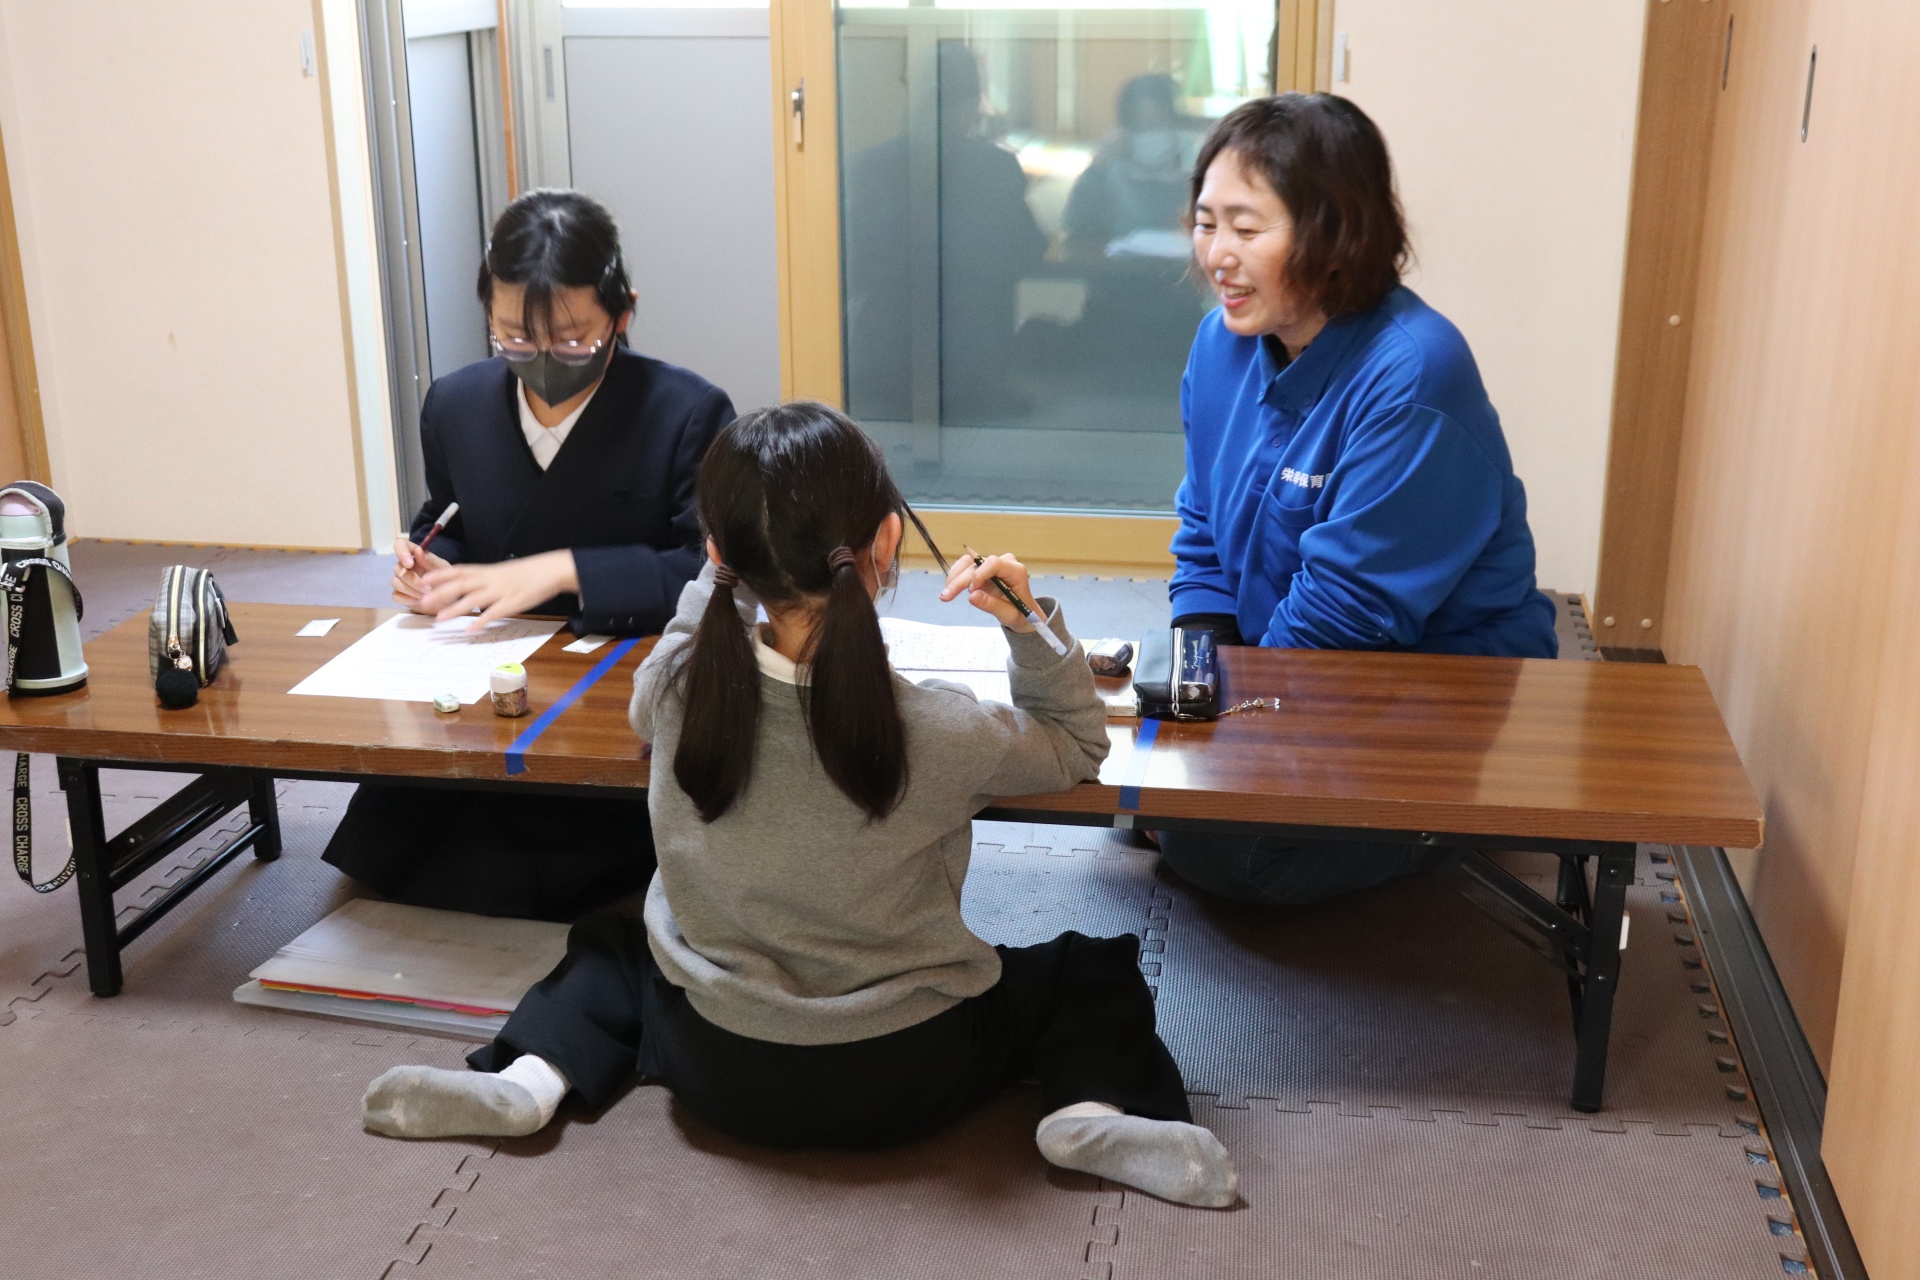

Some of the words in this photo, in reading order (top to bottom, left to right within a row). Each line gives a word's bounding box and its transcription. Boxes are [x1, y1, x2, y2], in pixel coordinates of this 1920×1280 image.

[10, 605, 24, 638] CROSS
[16, 752, 28, 788] HARGE
[16, 797, 29, 832] CROSS
[16, 835, 30, 875] CHARGE
